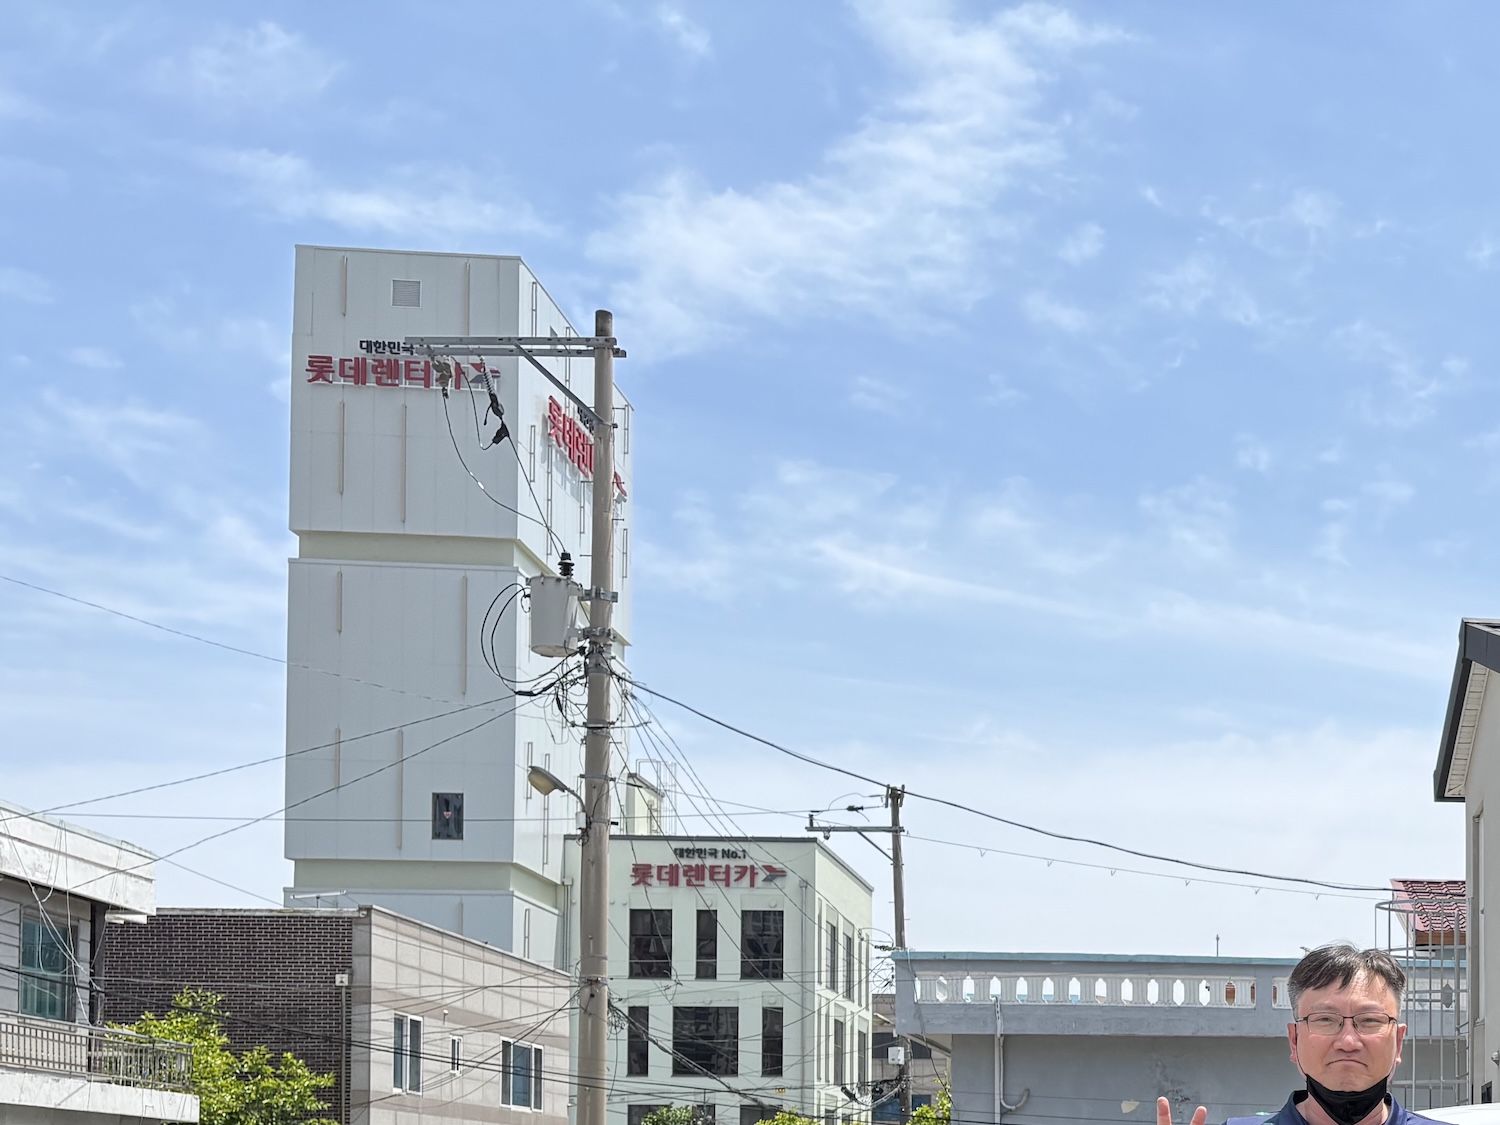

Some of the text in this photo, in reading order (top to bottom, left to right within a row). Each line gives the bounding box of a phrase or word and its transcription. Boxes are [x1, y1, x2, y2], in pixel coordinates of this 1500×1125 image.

[548, 395, 595, 480] 롯데렌
[674, 847, 747, 860] 대한민국 No.1
[630, 863, 759, 888] 롯데렌터카
